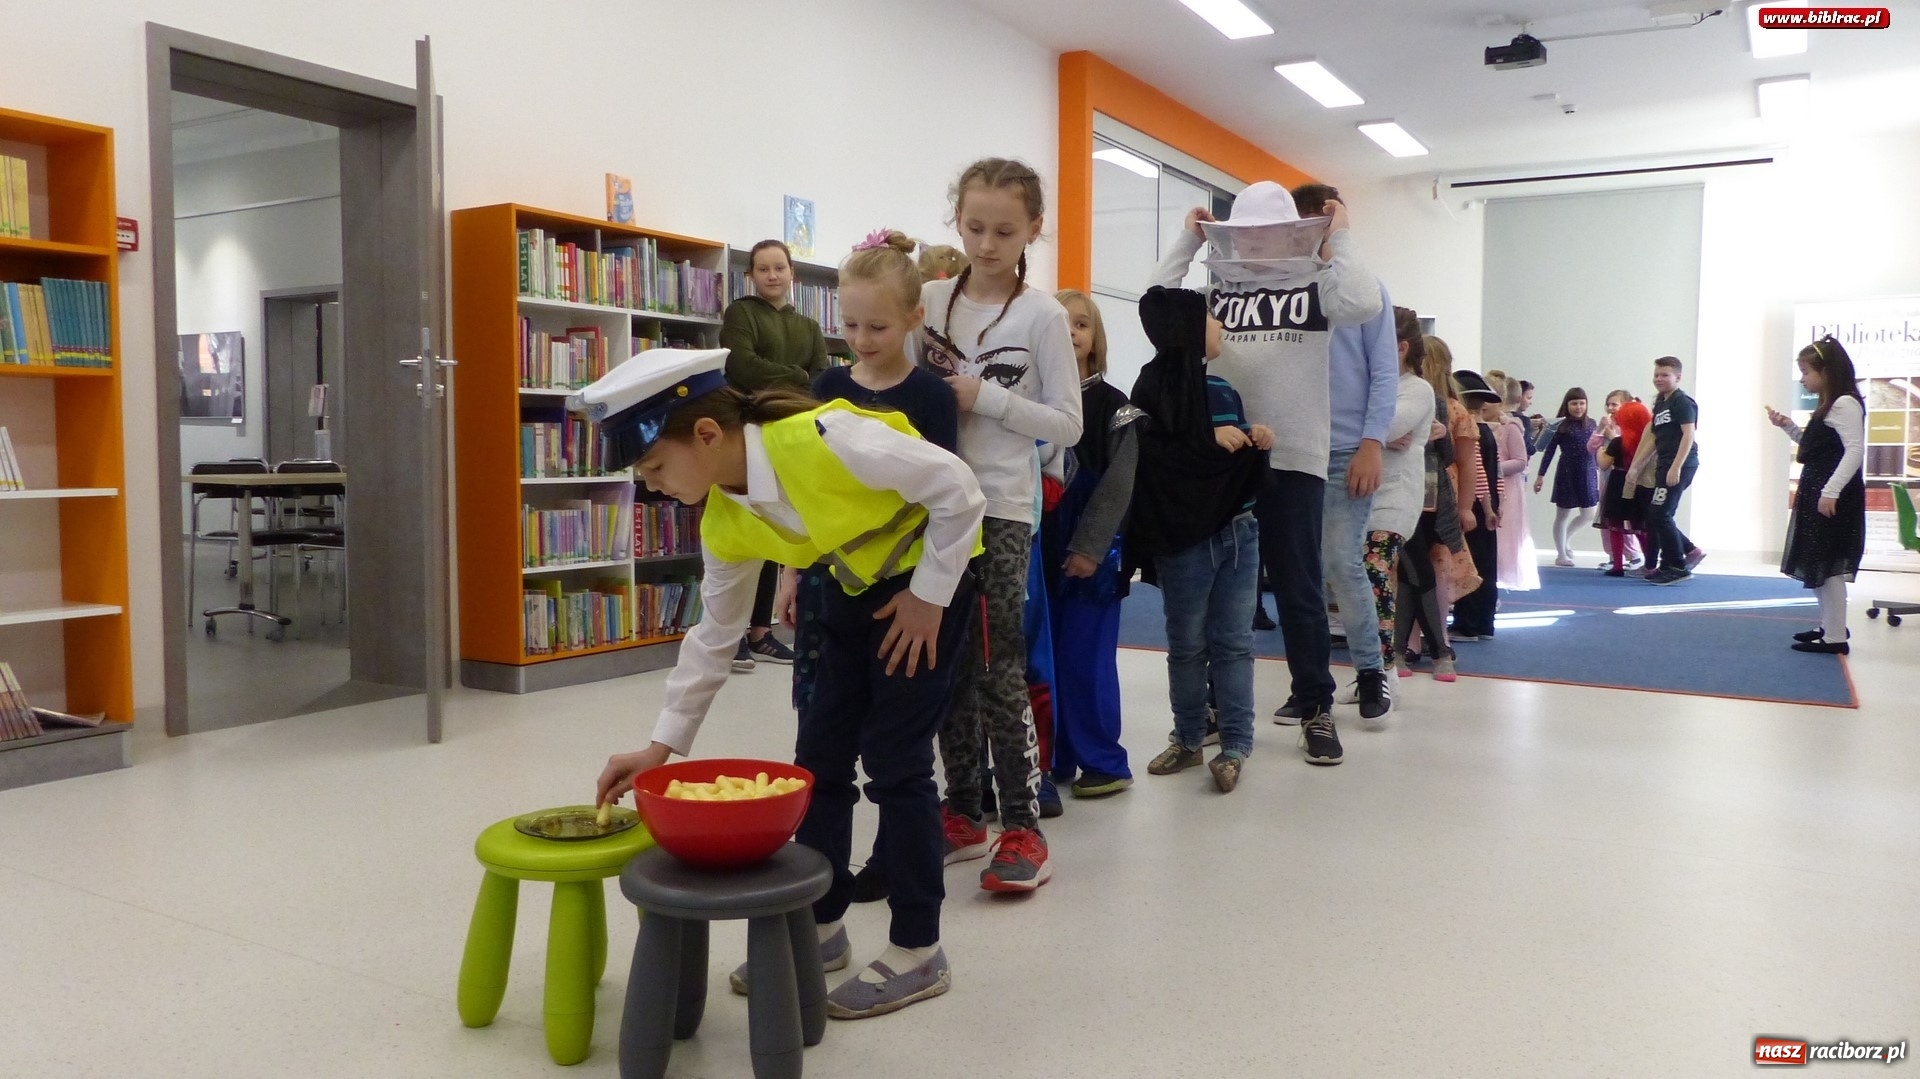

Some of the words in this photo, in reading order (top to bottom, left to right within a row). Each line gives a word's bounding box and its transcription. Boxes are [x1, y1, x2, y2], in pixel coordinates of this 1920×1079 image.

[520, 265, 528, 289] LAT
[1213, 291, 1310, 329] TOKYO
[1223, 333, 1257, 343] JAPAN
[1263, 331, 1304, 344] LEAGUE
[1811, 320, 1920, 345] Bblioteka
[634, 533, 642, 554] LAT
[1021, 705, 1042, 818] adidas
